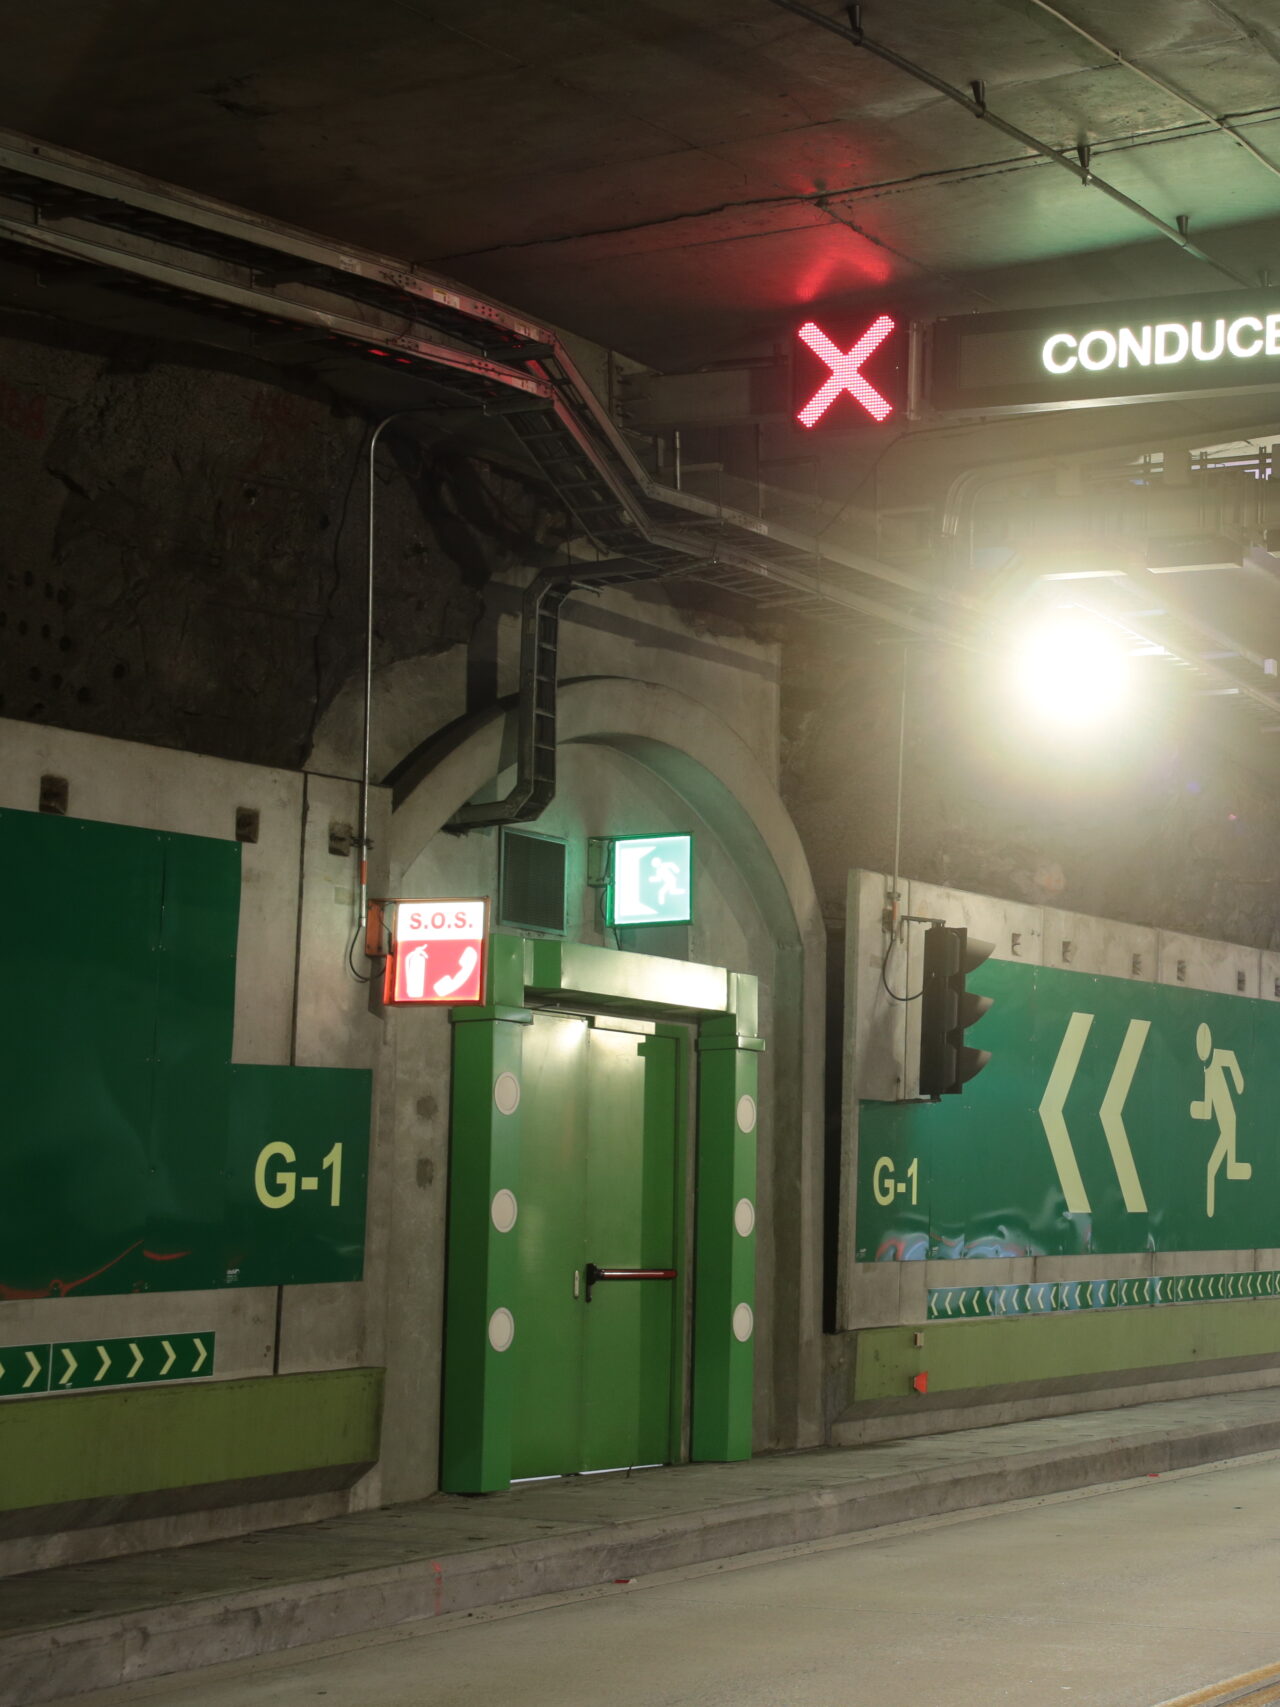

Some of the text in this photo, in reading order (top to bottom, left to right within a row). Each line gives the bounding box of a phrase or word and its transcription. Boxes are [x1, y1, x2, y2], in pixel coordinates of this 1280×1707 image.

[409, 911, 473, 930] S.O.S.
[255, 1141, 342, 1209] G-1
[873, 1156, 918, 1206] G-1
